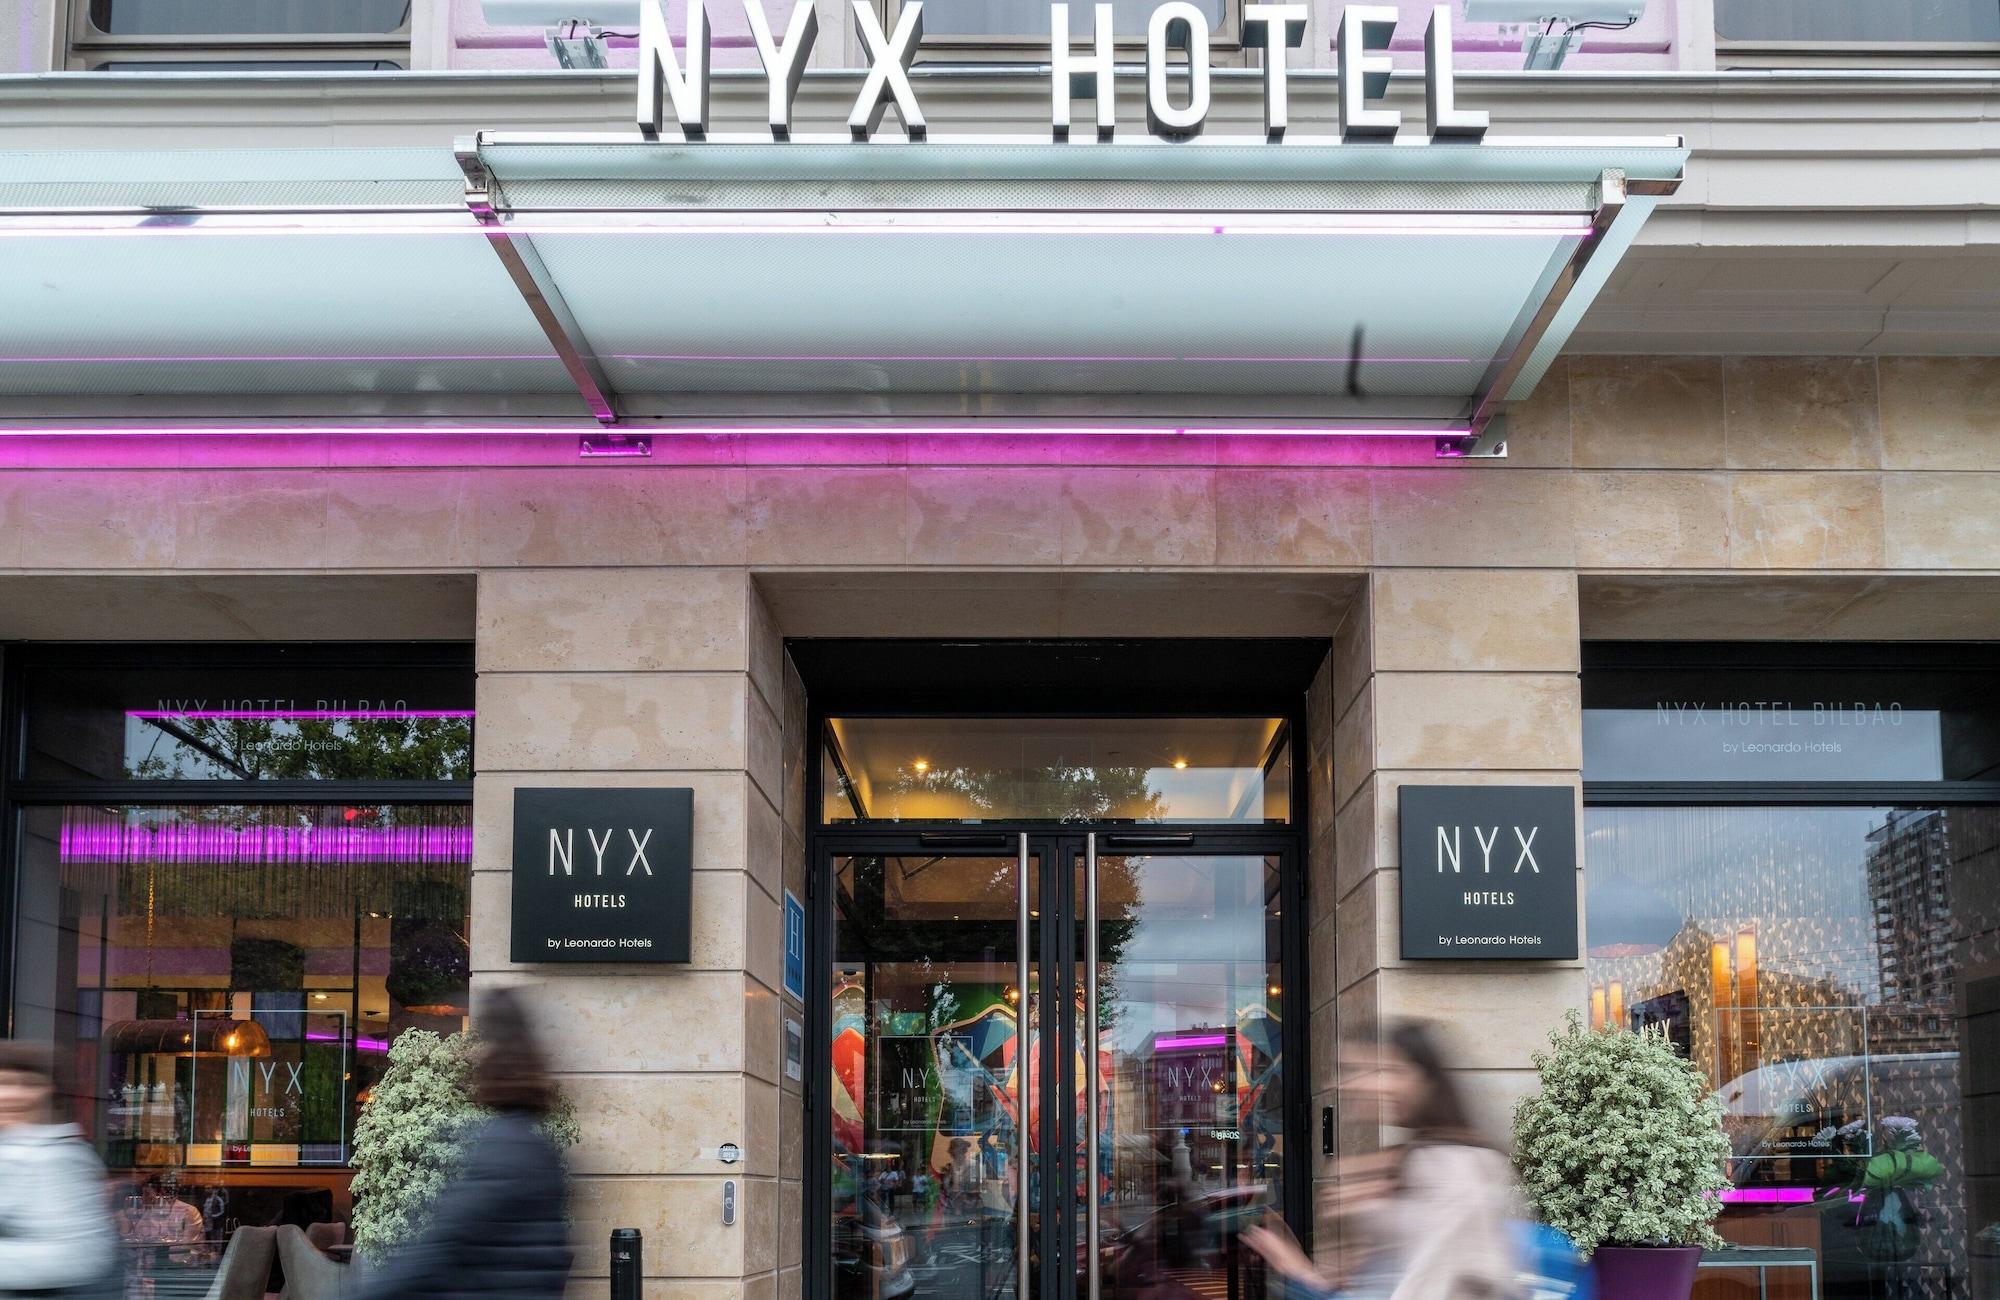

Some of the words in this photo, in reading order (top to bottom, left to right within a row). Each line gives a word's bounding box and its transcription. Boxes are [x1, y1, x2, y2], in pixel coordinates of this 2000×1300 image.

[636, 0, 927, 142] NYX
[1050, 1, 1490, 142] HOTEL
[157, 699, 208, 724] NYX
[1656, 701, 1706, 726] NYX
[1720, 701, 1800, 726] HOTEL
[1813, 701, 1903, 726] BILBAO
[304, 739, 342, 751] Hotels
[1722, 741, 1738, 755] by
[1742, 741, 1802, 753] Leonardo
[1804, 741, 1842, 753] Hotels
[549, 828, 653, 876] NYX
[1437, 826, 1540, 874] NYX
[574, 894, 626, 908] HOTELS
[1464, 891, 1515, 905] HOTELS
[547, 937, 562, 950] by
[564, 937, 617, 948] Leonardo
[619, 937, 652, 948] Hotels
[789, 908, 801, 961] H
[1438, 935, 1452, 946] by
[1455, 935, 1507, 945] Leonardo
[1509, 935, 1542, 945] Hotels
[234, 1061, 304, 1095] NYX
[1168, 1066, 1213, 1088] NYX
[1758, 1058, 1828, 1091] NYX
[250, 1107, 286, 1118] HOTELS
[1775, 1103, 1812, 1113] HOTELS
[1772, 1140, 1808, 1148] Leonardo
